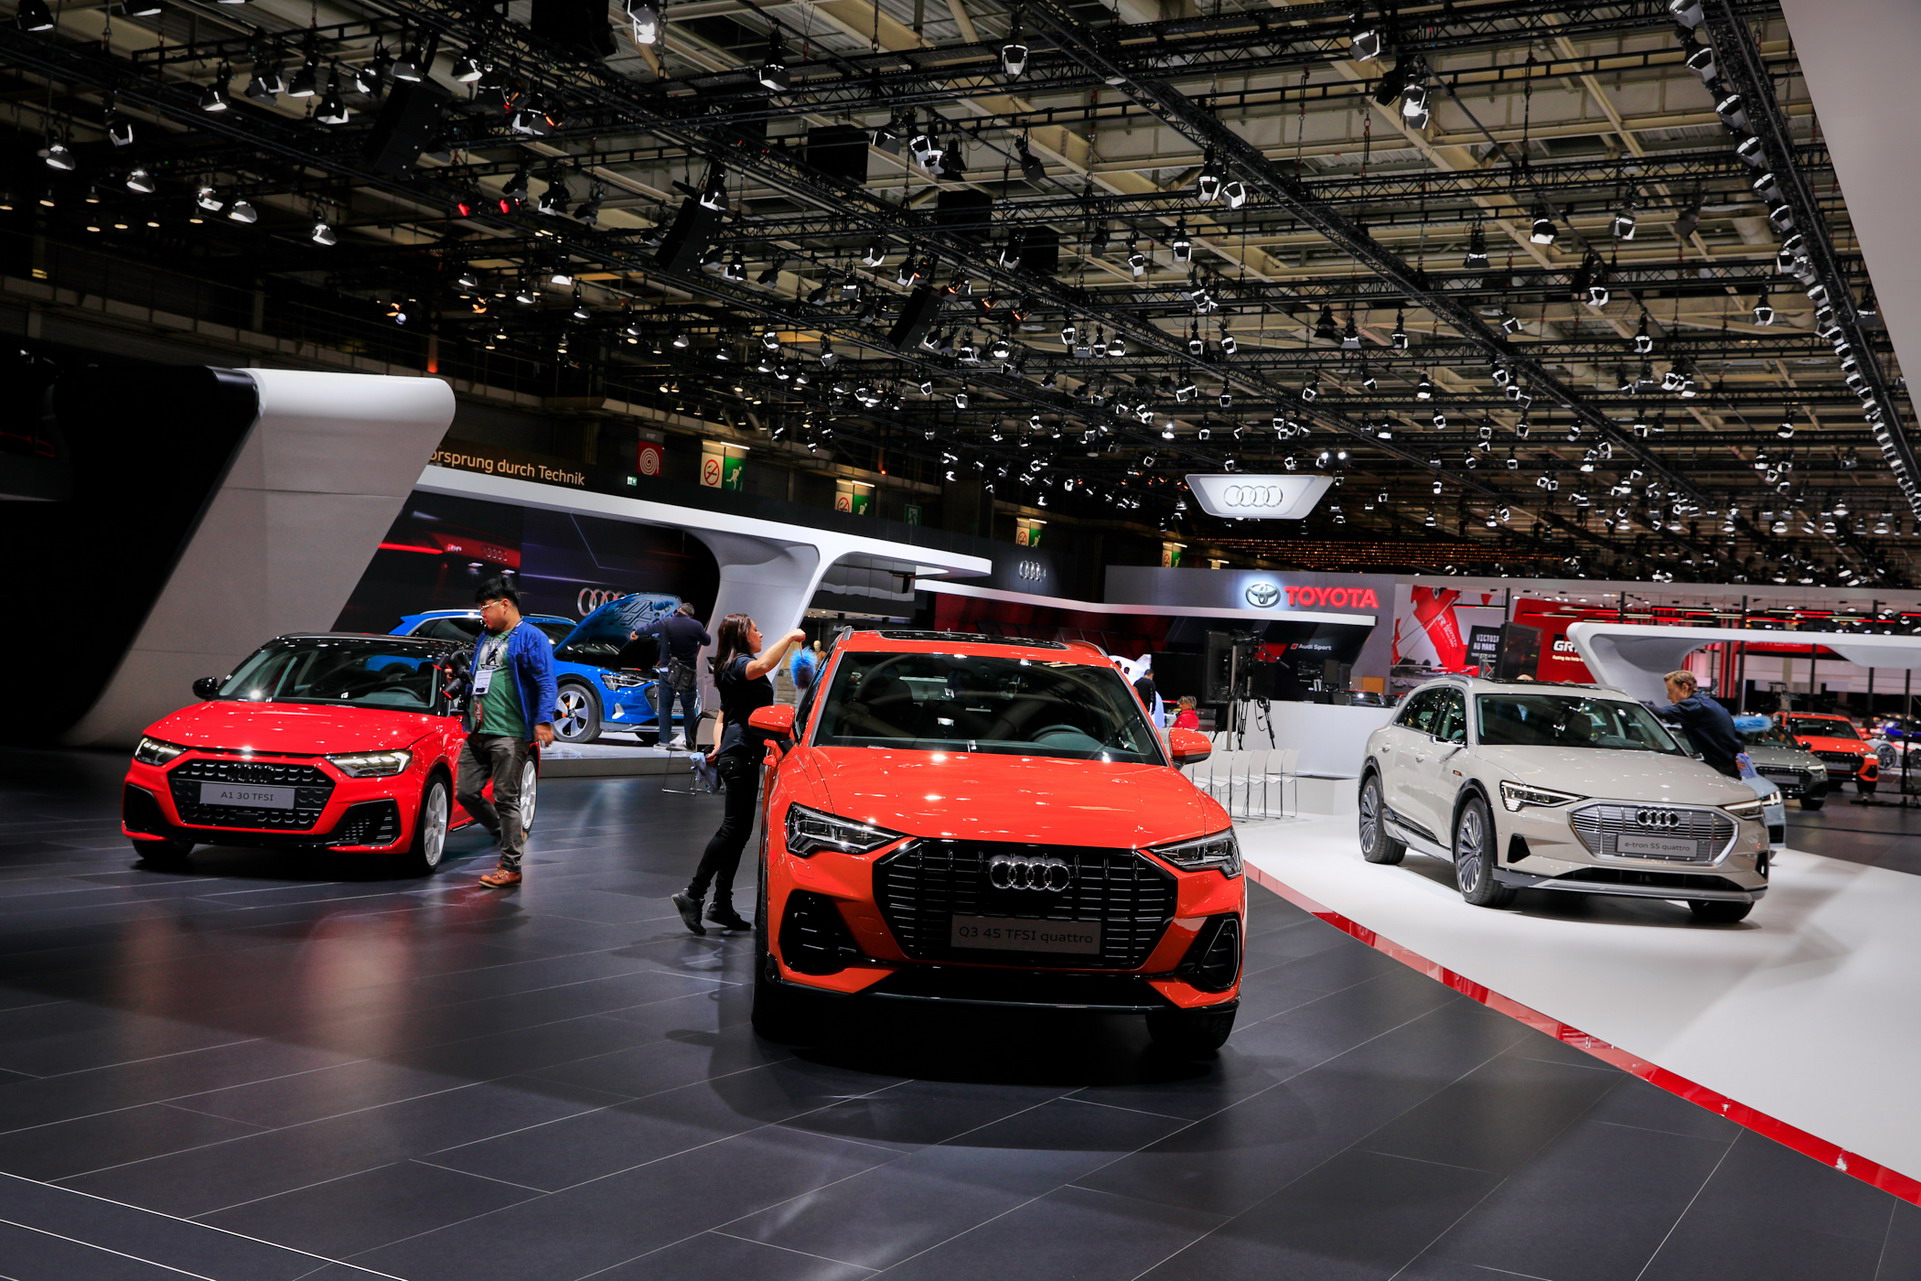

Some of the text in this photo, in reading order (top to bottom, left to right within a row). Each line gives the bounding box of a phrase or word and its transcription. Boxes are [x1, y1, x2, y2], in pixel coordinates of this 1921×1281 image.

[430, 450, 585, 486] orsprung durch Technik
[1284, 585, 1379, 608] TOYOTA
[1553, 640, 1578, 653] GR
[221, 791, 274, 801] A1 30 TFSI
[959, 926, 1093, 944] Q3 45 TFSI quattro
